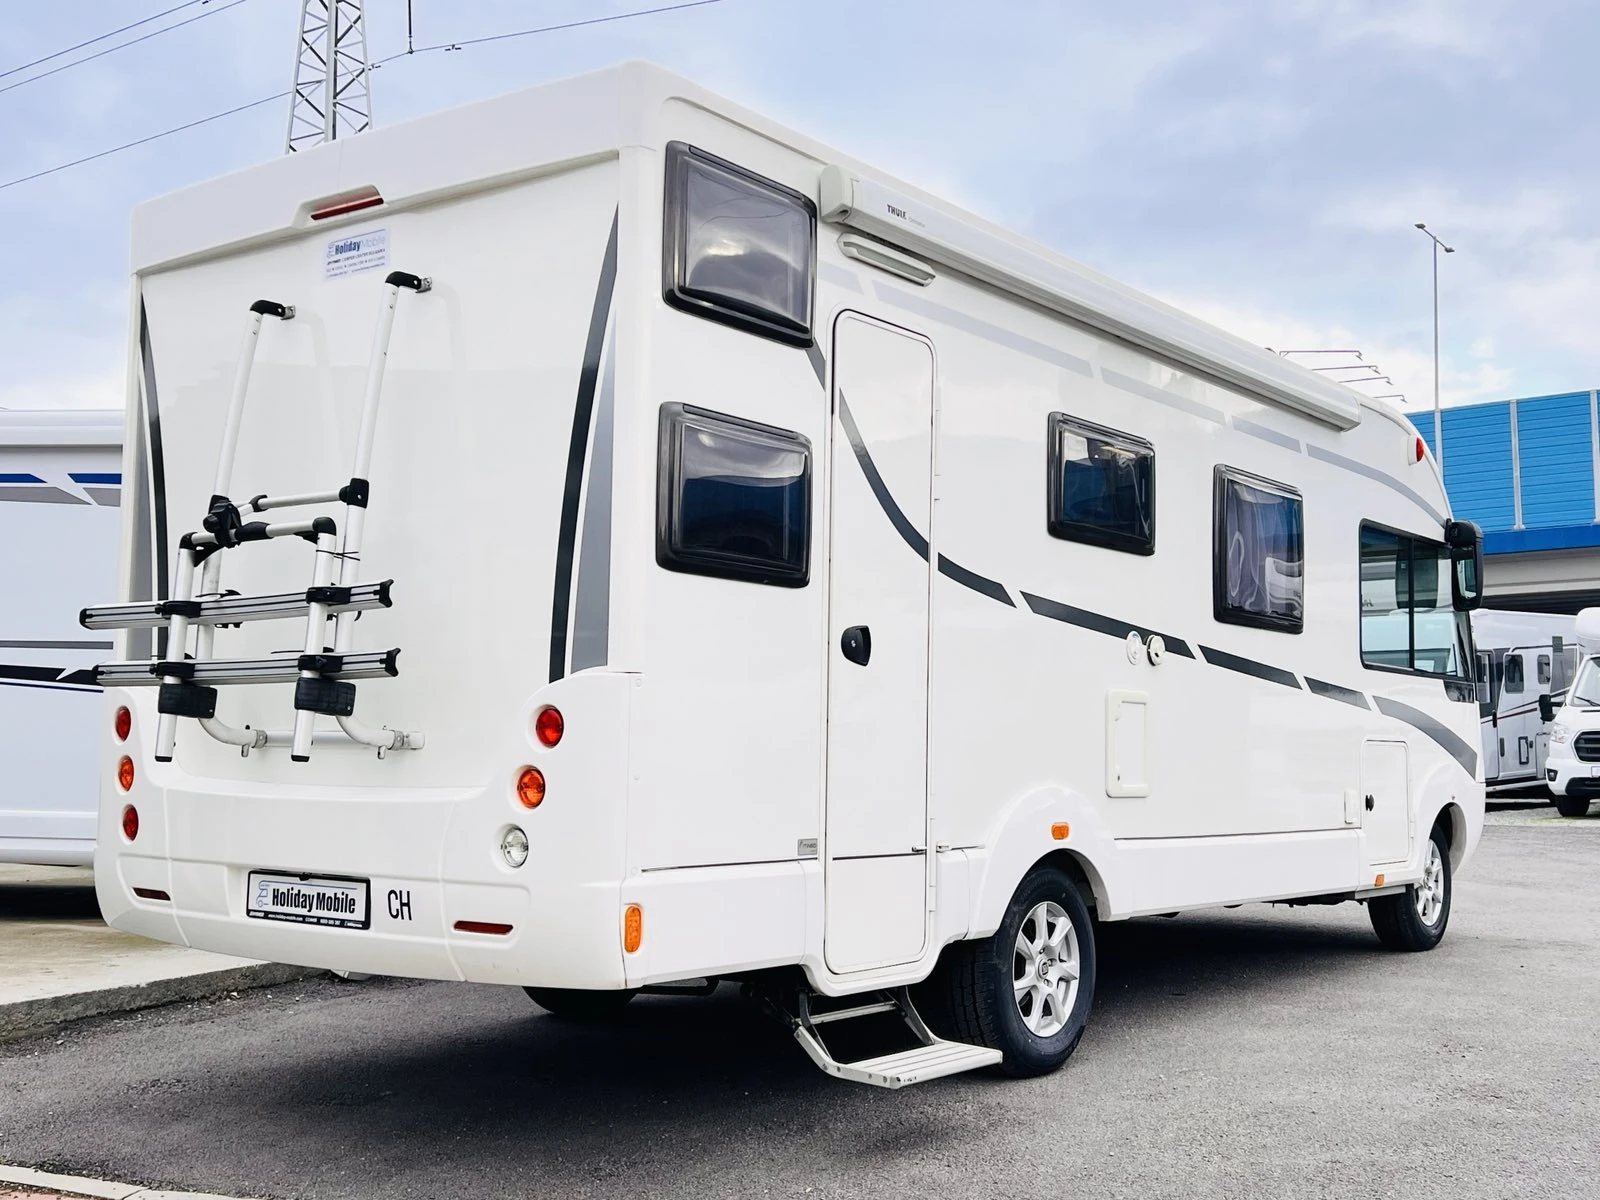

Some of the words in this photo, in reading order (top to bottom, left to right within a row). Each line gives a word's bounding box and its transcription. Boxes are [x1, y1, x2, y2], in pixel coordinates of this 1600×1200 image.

[887, 204, 906, 219] THULE
[335, 240, 361, 255] Holiday
[272, 887, 315, 913] Holiday
[315, 891, 356, 914] Mobile
[387, 889, 413, 921] CH
